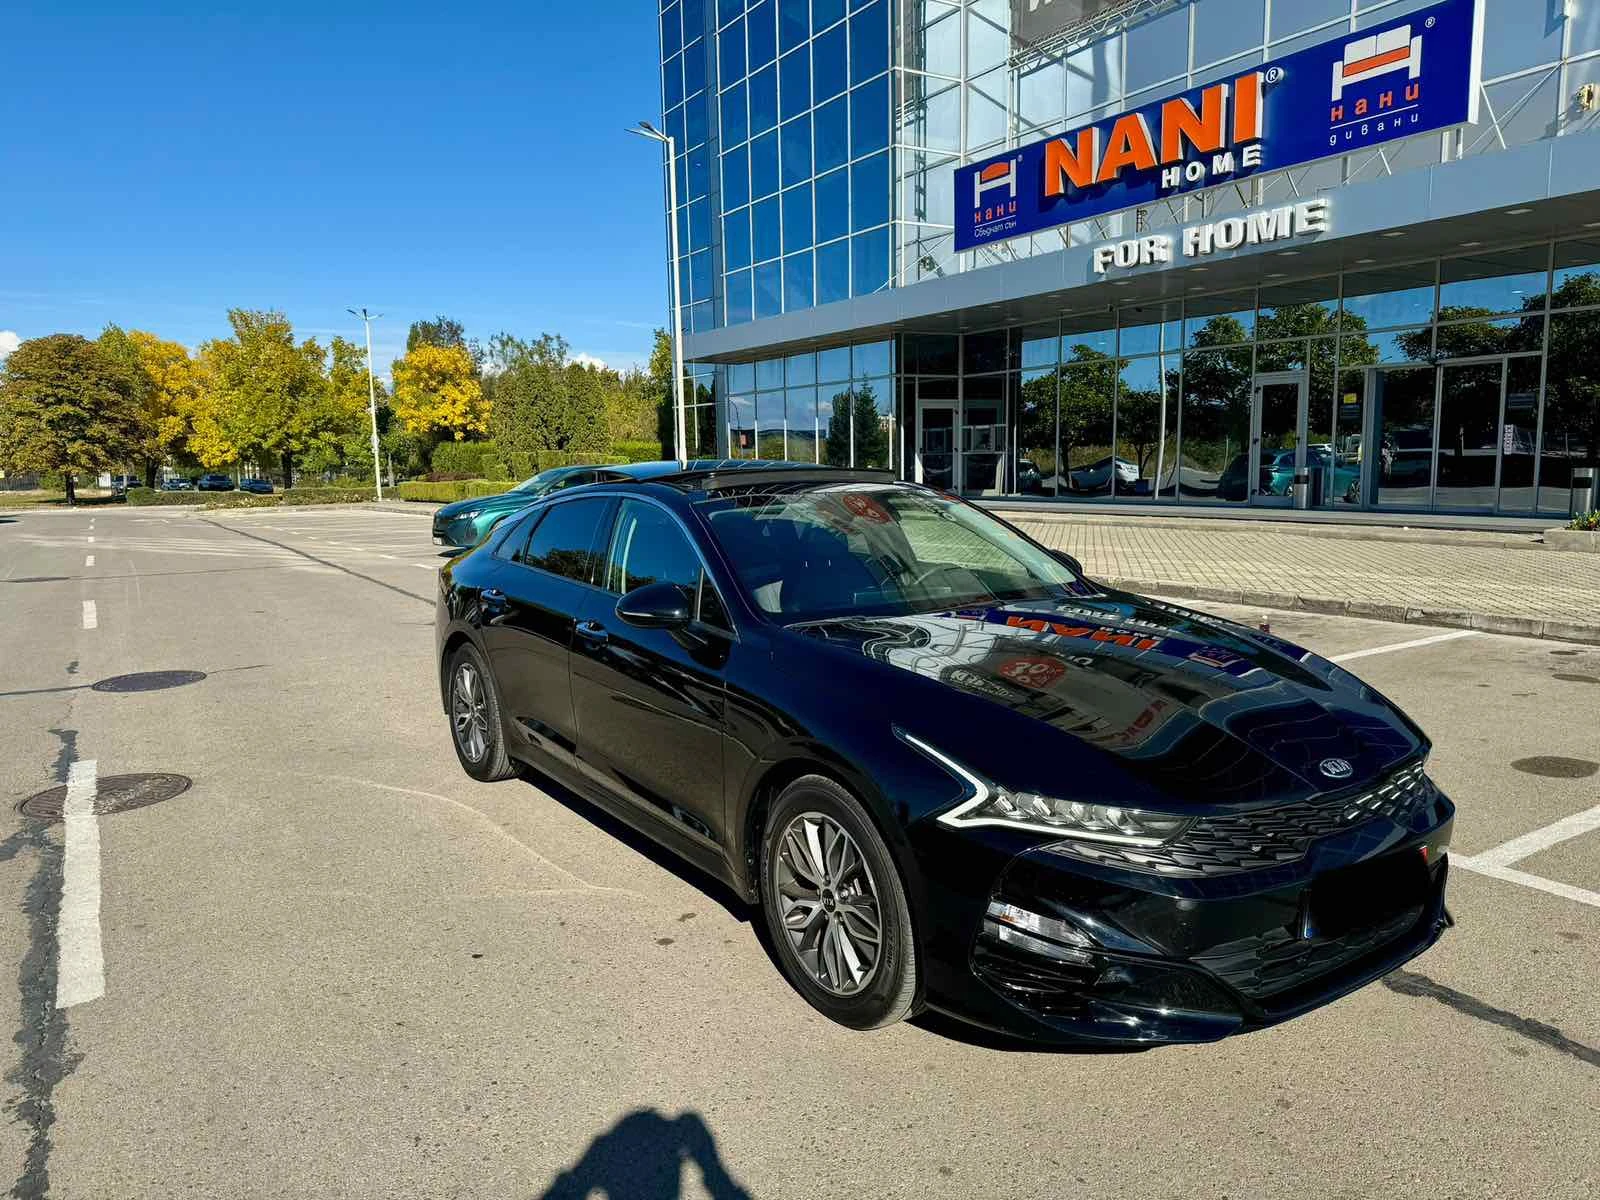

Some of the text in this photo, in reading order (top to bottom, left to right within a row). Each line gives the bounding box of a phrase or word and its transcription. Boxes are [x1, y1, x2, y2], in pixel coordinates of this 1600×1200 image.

[1045, 72, 1264, 197] NANI
[1162, 144, 1263, 188] HOME
[1093, 198, 1329, 273] FOR HOME
